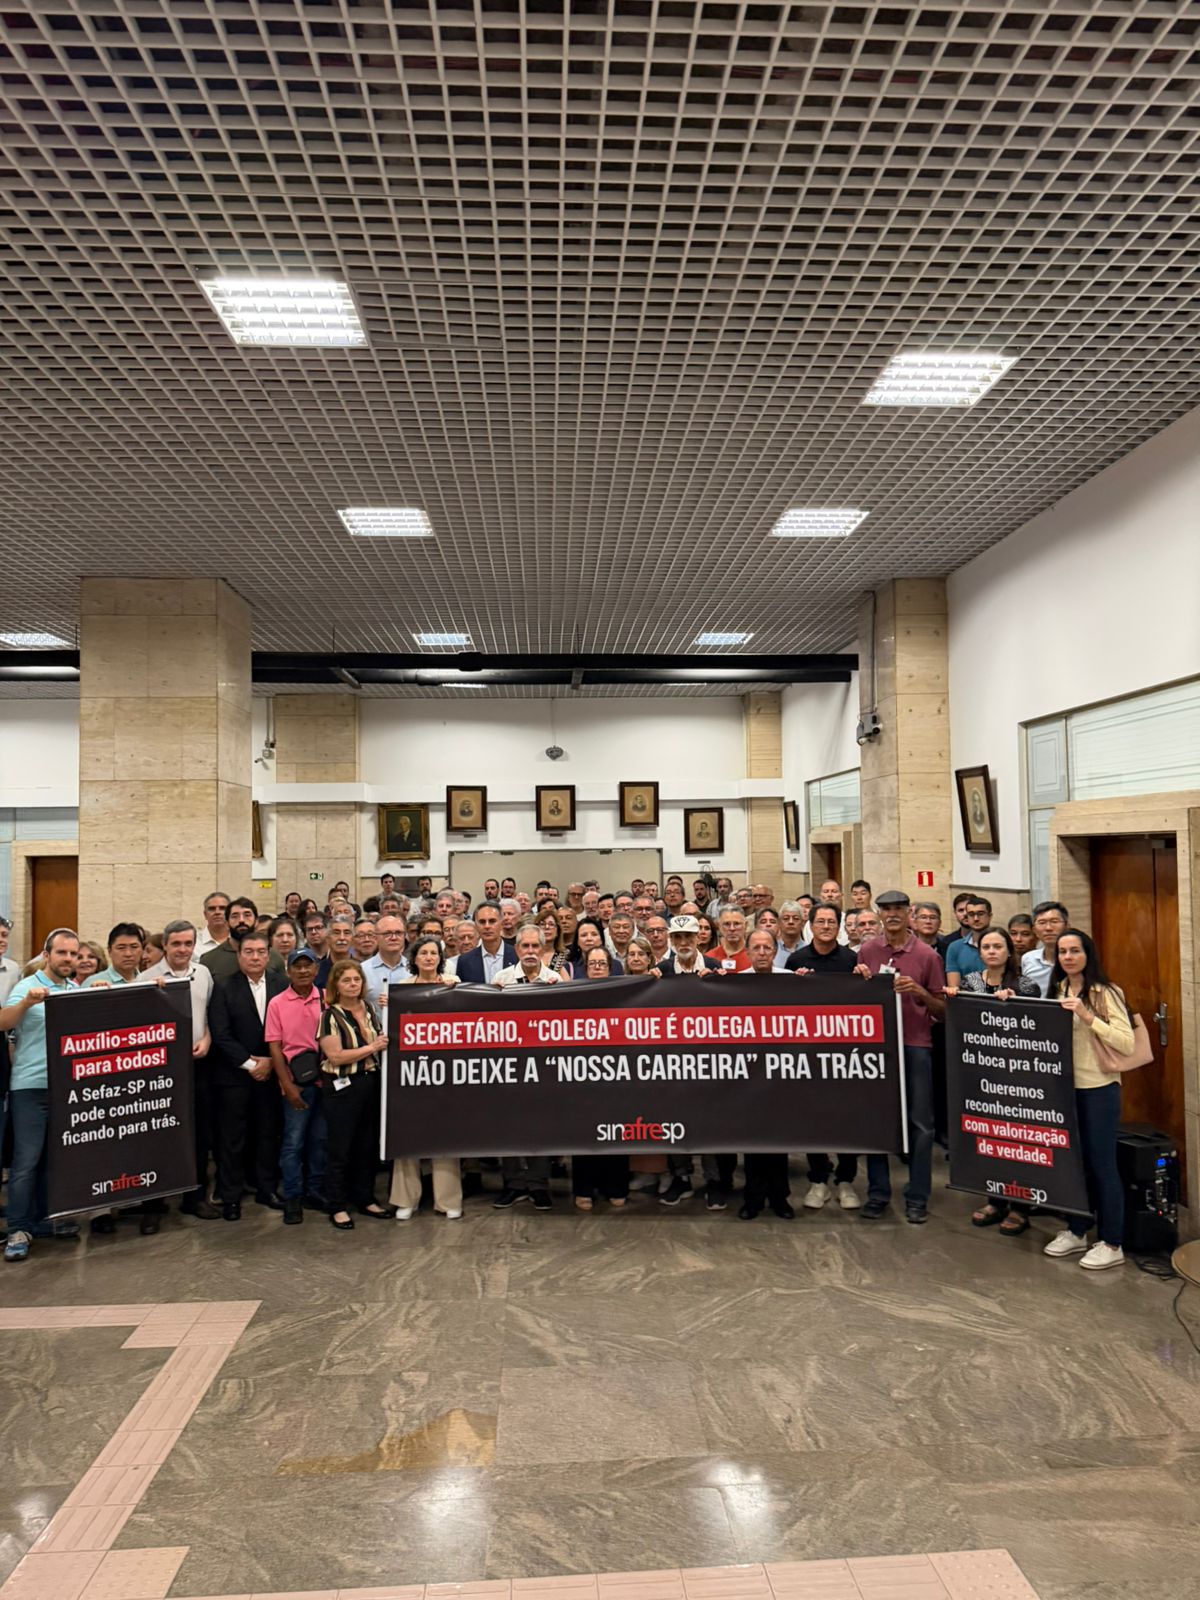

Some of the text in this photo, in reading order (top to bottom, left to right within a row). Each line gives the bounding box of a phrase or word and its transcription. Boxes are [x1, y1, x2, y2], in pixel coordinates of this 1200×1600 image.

[404, 1016, 523, 1045] SECRETÁRIO,
[626, 1016, 661, 1040] QUE
[667, 1012, 677, 1038] É
[683, 1016, 755, 1037] COLEGA
[761, 1015, 808, 1037] LUTA
[813, 1014, 874, 1036] JUNTO
[981, 1012, 1035, 1030] Chega de
[63, 1026, 175, 1054] Auxílio-saúde
[964, 1032, 1059, 1053] reconhecimento
[75, 1050, 165, 1080] para todos!
[400, 1055, 446, 1086] NÃO
[453, 1058, 517, 1085] DEIXE
[523, 1058, 539, 1083] A
[765, 1053, 811, 1078] PRA
[817, 1047, 885, 1078] TRÁS!
[962, 1050, 1062, 1075] da boca pra fora!
[68, 1076, 173, 1104] A Sefaz-SP não
[980, 1079, 1044, 1100] Queremos
[71, 1097, 172, 1126] pode continuar
[966, 1099, 1064, 1123] reconhecimento
[62, 1115, 180, 1145] ficando para trás.
[597, 1116, 685, 1143] sinafresp
[965, 1119, 1066, 1148] com valorização
[978, 1141, 1051, 1164] de verdade.
[92, 1170, 157, 1195] sinafresp
[986, 1180, 1047, 1204] sinafresp
